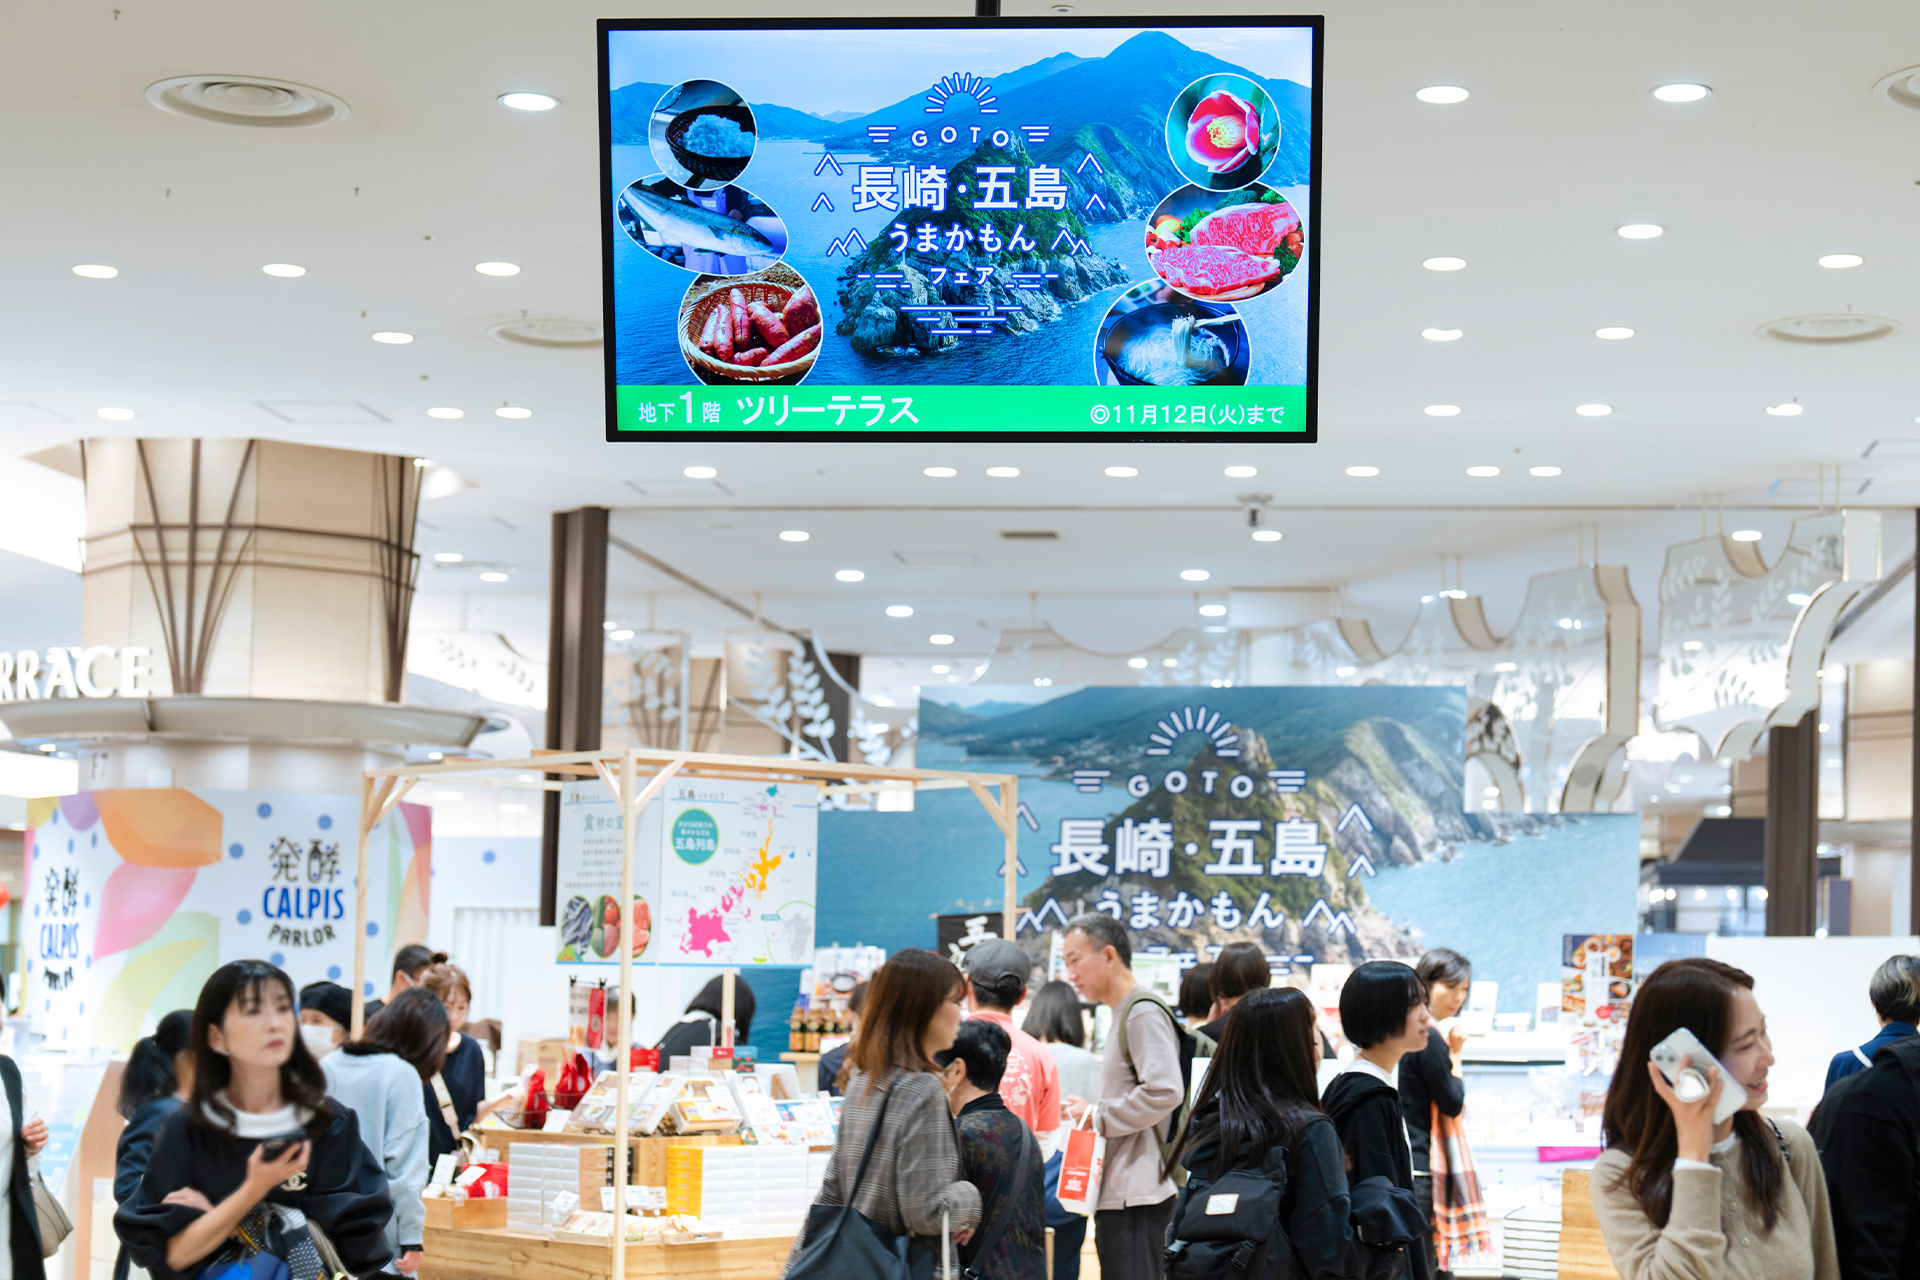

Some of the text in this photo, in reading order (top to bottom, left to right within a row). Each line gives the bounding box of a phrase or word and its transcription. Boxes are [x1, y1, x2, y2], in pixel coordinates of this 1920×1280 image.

[912, 126, 1010, 147] GOTO
[852, 164, 1069, 211] 長崎・五島
[890, 222, 1036, 252] うまかもん
[930, 266, 995, 285] フェア
[638, 391, 920, 427] 地下1階 ツリーテラス
[1127, 770, 1255, 799] GOTO
[1050, 816, 1328, 878] 長崎・五島
[263, 887, 344, 919] CALPIS
[1095, 889, 1286, 930] うまかもん
[268, 923, 337, 947] PARLOR
